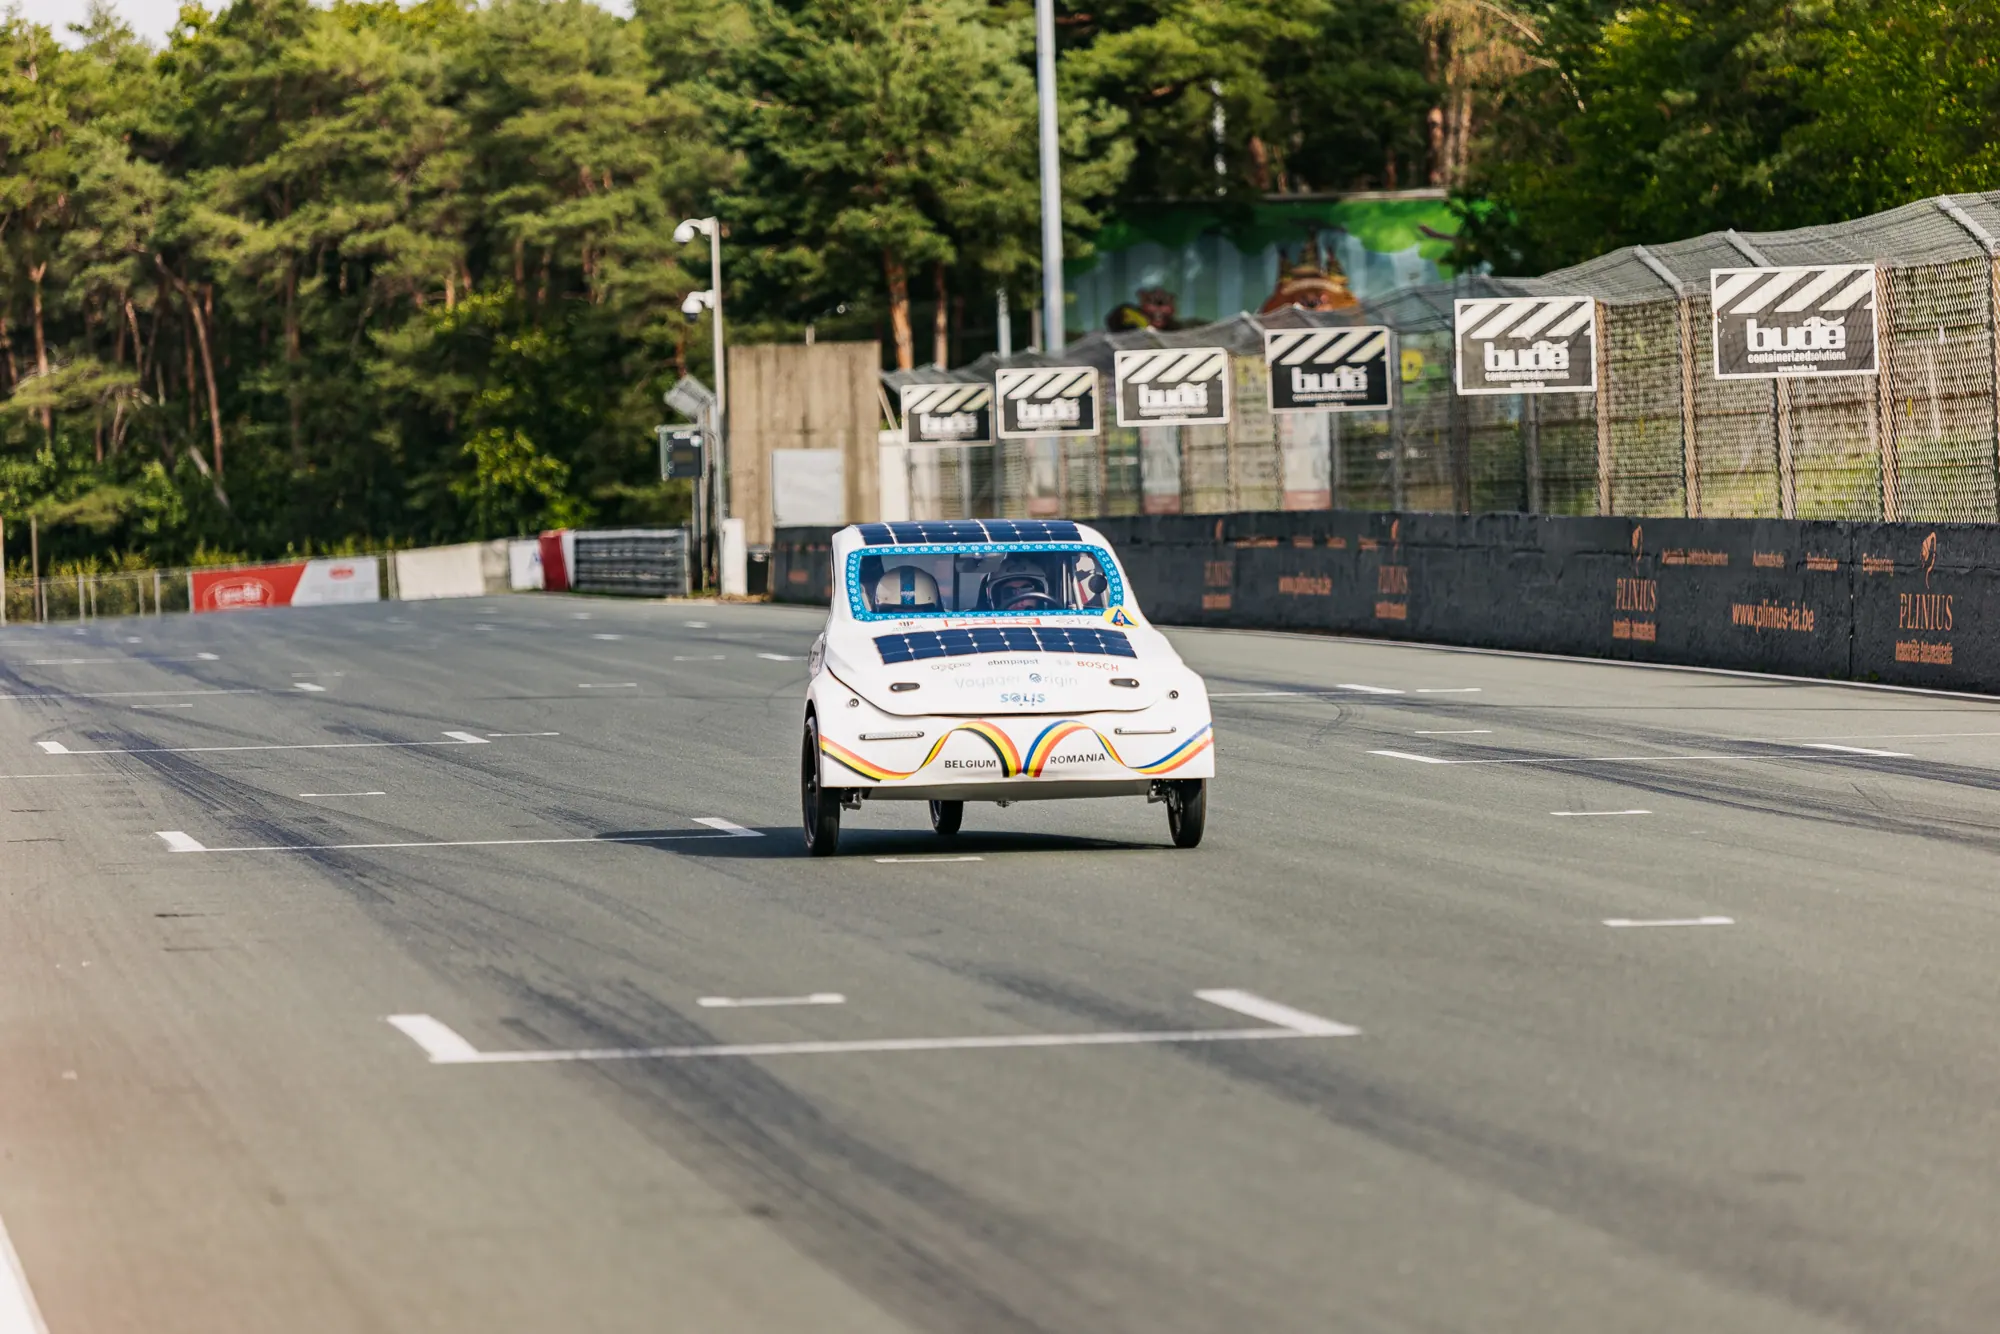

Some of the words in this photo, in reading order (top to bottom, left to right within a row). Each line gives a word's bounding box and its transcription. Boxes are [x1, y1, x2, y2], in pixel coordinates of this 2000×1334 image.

[1616, 578, 1657, 612] PLINIUS
[1732, 598, 1815, 634] www.plinius-ia.be
[1899, 593, 1953, 631] PLINIUS
[1077, 661, 1120, 673] BOSCH
[944, 759, 997, 769] BELGIUM
[1050, 753, 1106, 765] ROMANIA
